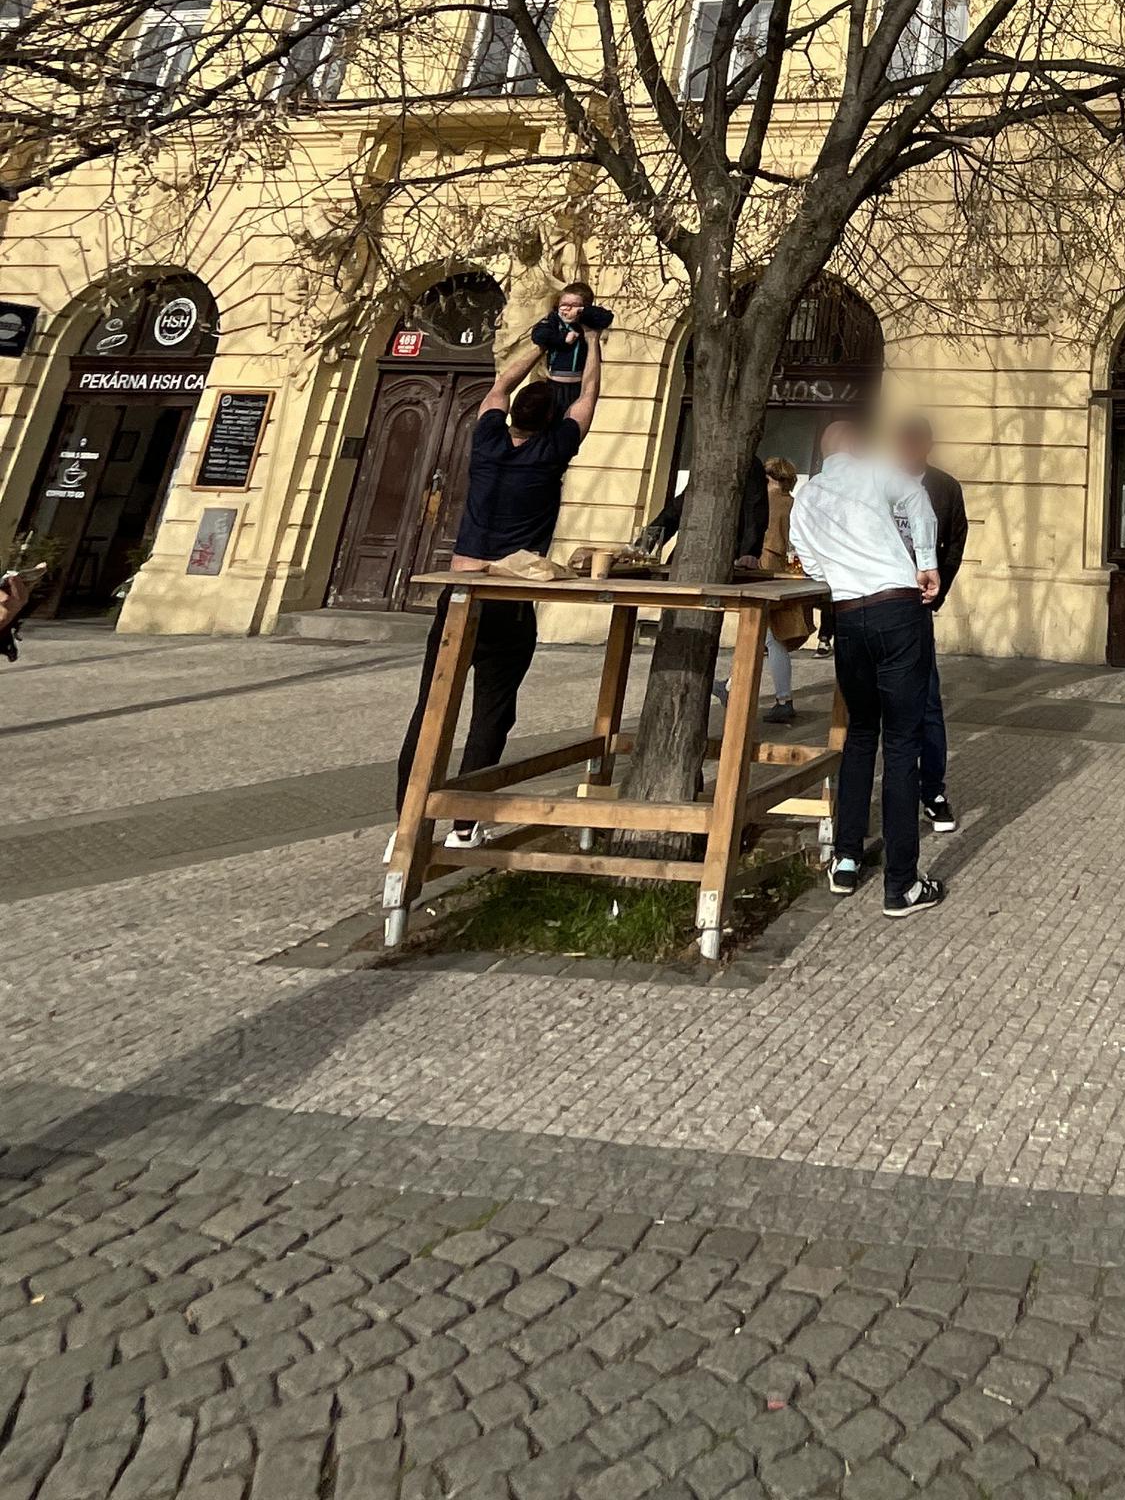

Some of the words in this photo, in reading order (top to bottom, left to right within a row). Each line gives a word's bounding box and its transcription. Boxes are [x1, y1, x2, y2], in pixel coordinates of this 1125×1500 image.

[160, 315, 190, 329] HSH
[399, 334, 417, 345] 469
[79, 371, 147, 390] PEKÁRNA
[152, 374, 182, 390] HSH
